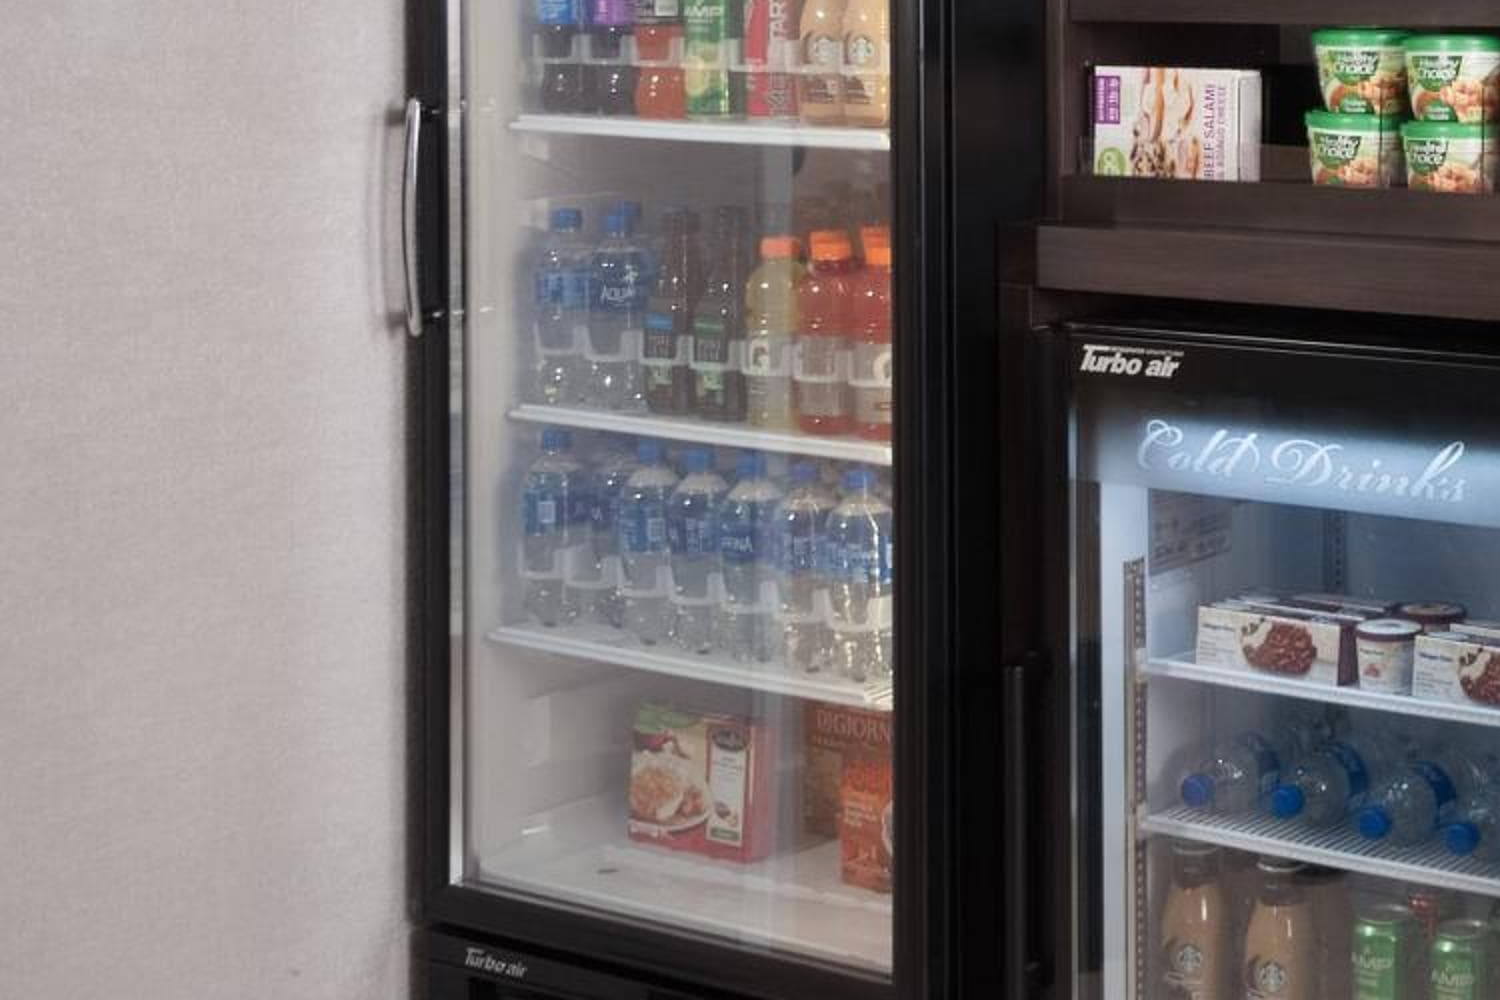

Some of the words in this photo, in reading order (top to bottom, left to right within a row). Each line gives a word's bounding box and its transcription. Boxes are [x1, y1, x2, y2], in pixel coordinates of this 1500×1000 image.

[1203, 83, 1215, 139] SALAMI
[1080, 344, 1143, 376] Turbo
[1144, 356, 1181, 378] air
[1138, 418, 1261, 478] Cold
[1263, 438, 1470, 502] Drinks
